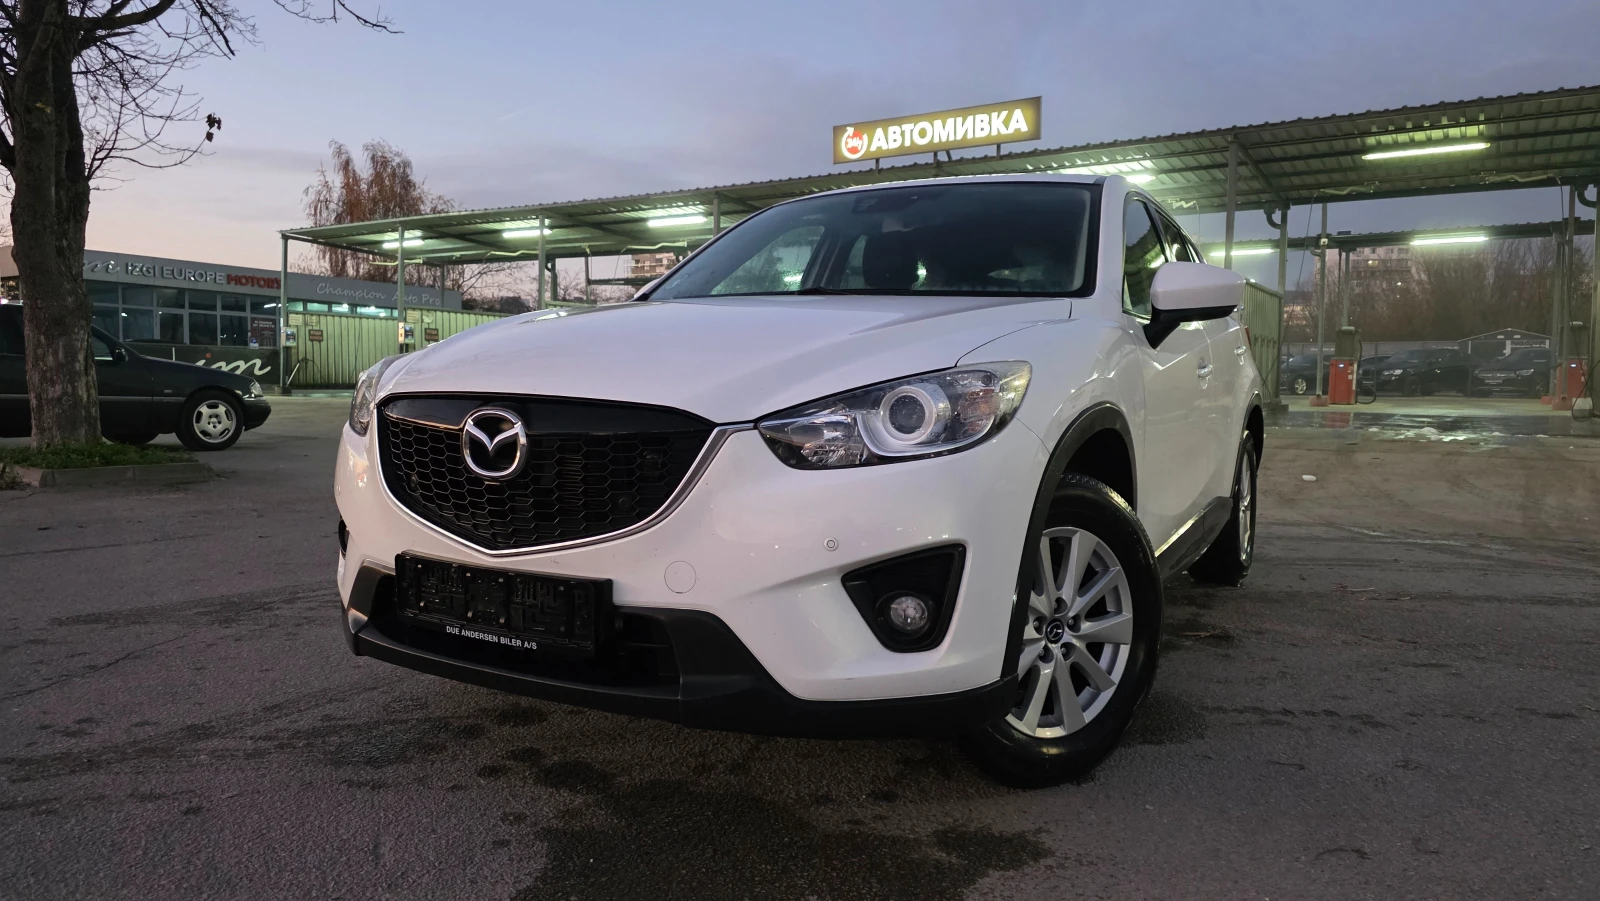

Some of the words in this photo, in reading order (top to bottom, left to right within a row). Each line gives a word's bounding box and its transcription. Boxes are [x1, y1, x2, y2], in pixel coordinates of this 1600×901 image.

[870, 108, 1029, 152] АВТОМИВКА
[127, 262, 158, 277] IZGI
[162, 266, 225, 284] EUROPE
[421, 293, 441, 306] Pro
[446, 625, 460, 636] DUE
[461, 628, 498, 643] ANDERSEN
[500, 635, 522, 648] BILER
[523, 640, 537, 650] A/S
